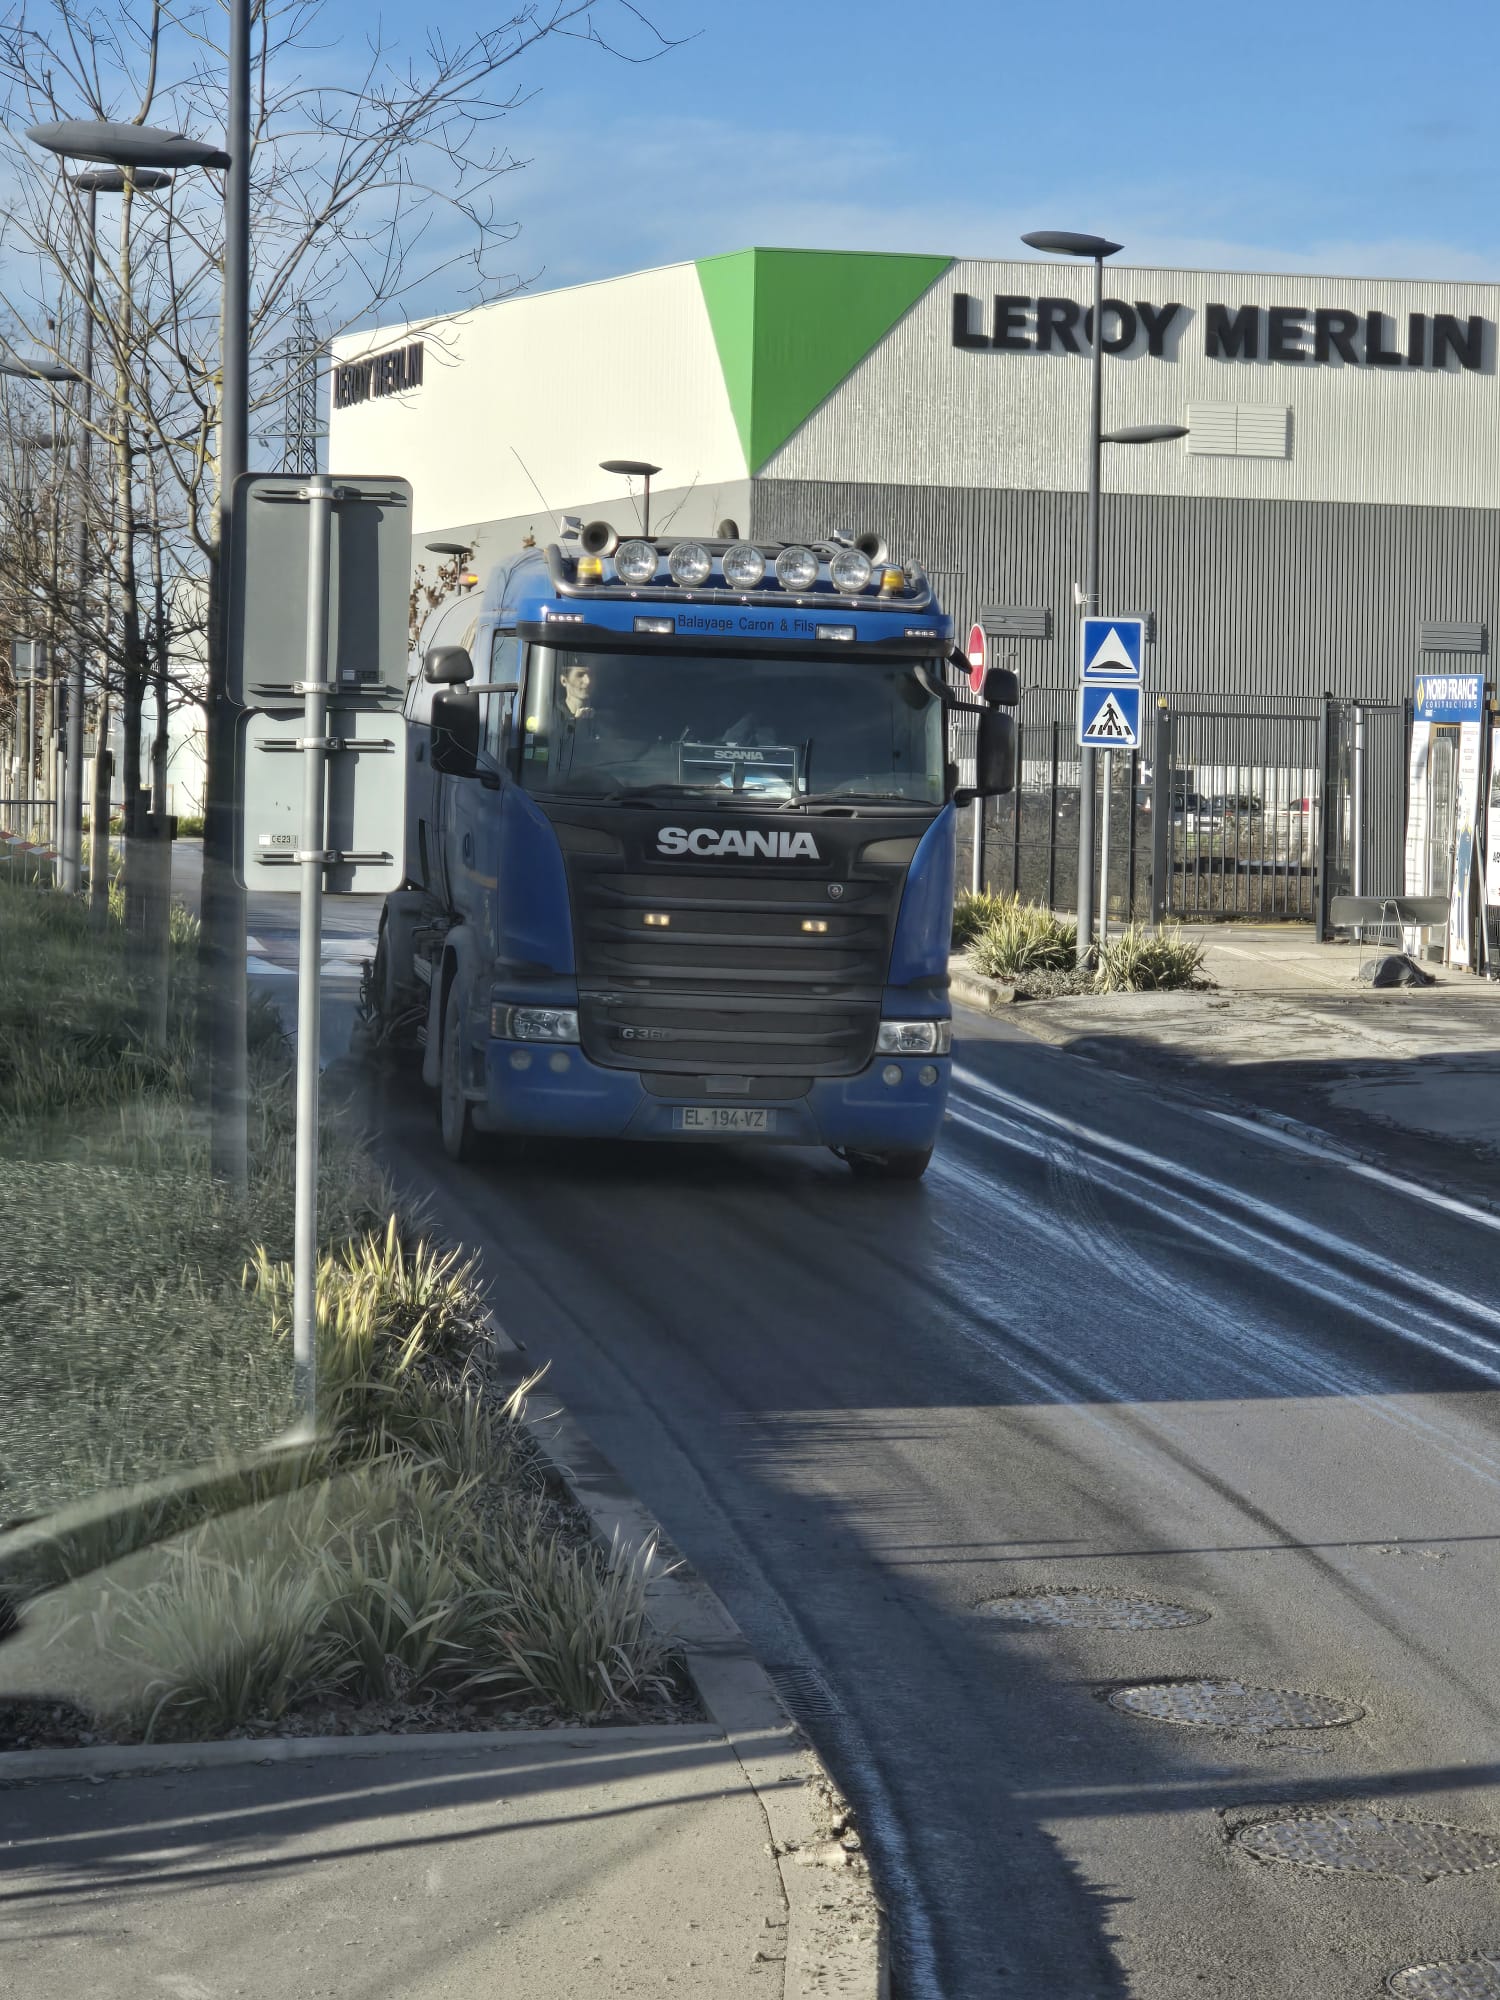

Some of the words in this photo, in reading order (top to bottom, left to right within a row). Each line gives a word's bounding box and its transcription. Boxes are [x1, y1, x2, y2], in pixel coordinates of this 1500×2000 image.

[953, 293, 1183, 356] LEROY
[1205, 303, 1482, 370] MERLIN
[678, 614, 733, 632] Balayage
[738, 617, 774, 631] Caron
[780, 619, 788, 632] &
[794, 619, 814, 632] Fils
[1426, 679, 1447, 700] NORD
[1448, 679, 1478, 700] FRANCE
[714, 750, 764, 761] SCANIA
[656, 827, 820, 859] SCANIA
